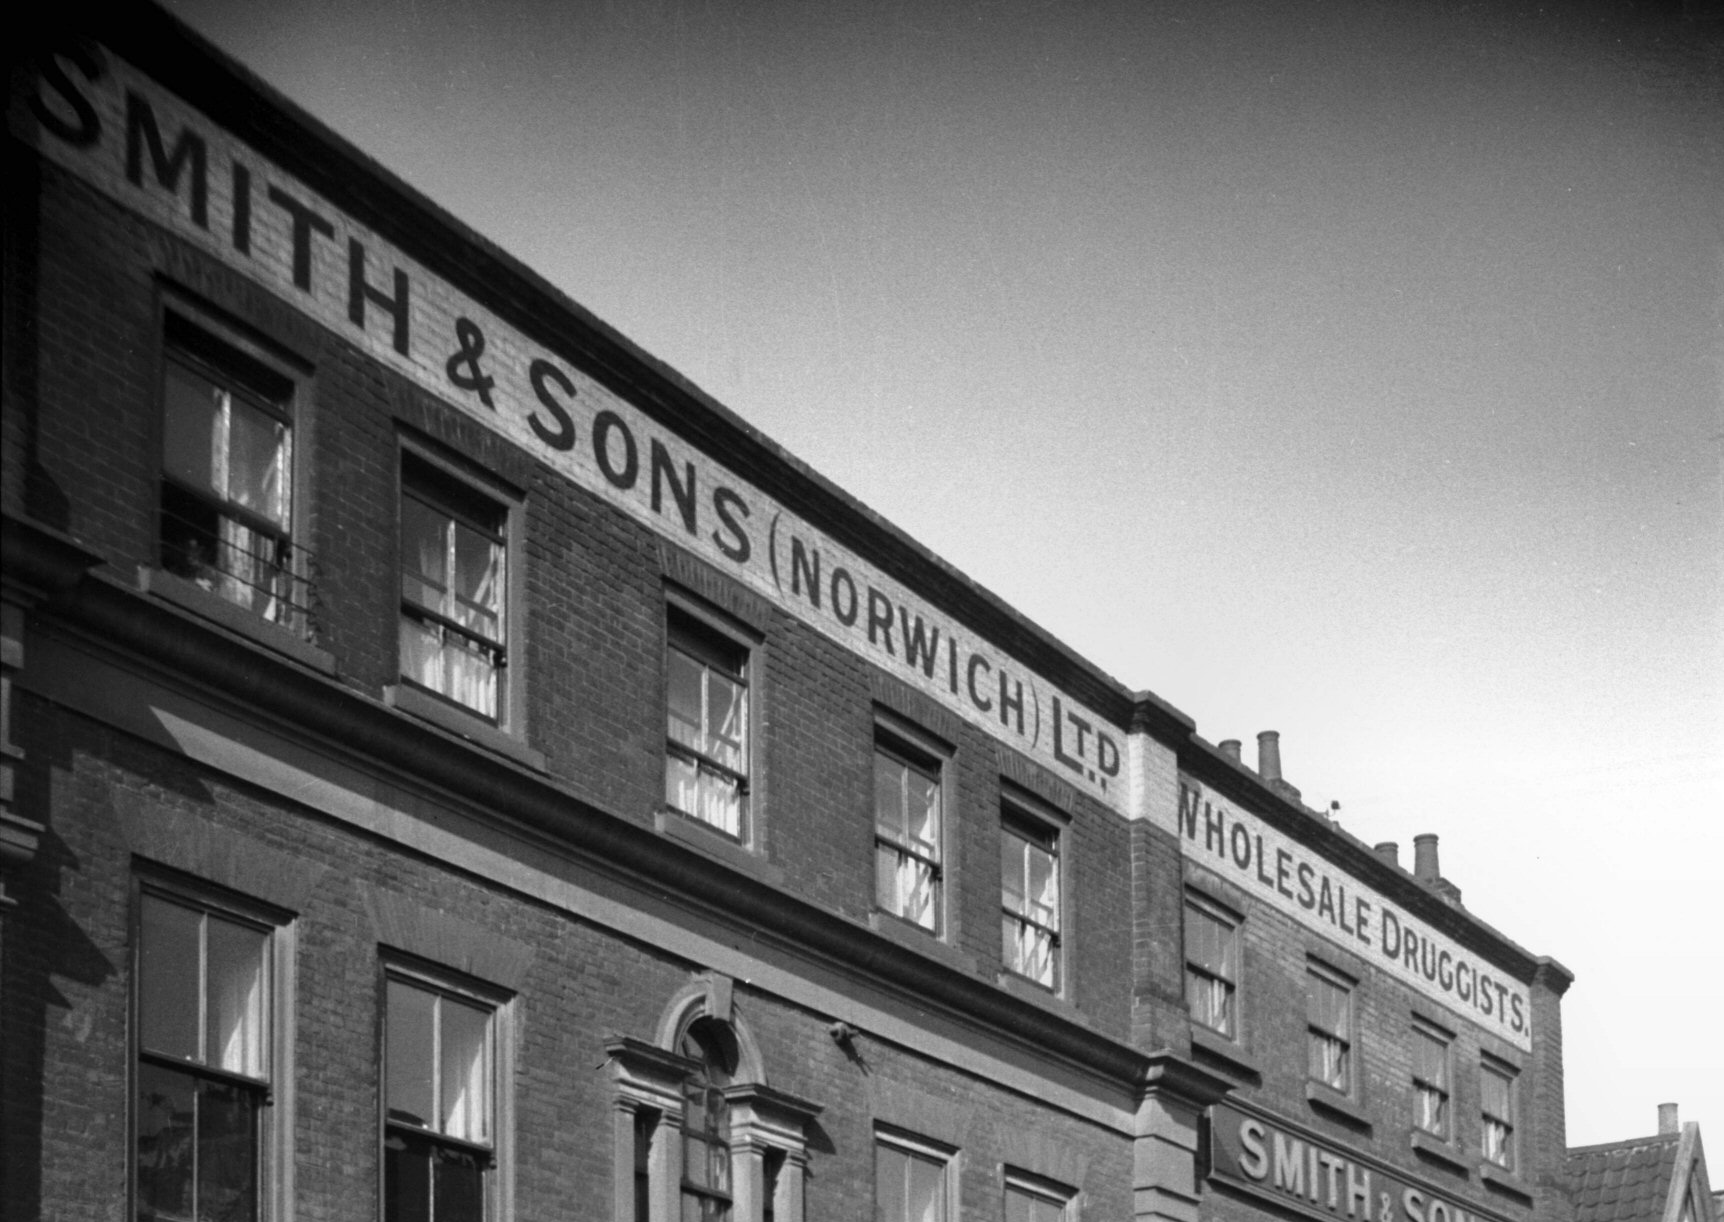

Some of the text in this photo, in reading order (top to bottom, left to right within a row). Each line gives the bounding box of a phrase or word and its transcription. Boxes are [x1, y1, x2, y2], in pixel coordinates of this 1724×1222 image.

[30, 40, 410, 359] SMITH
[445, 316, 496, 411] &
[527, 358, 751, 563] SONS
[769, 510, 1039, 750] (NORWICH)
[1382, 907, 1529, 1037] DRUGGISTS.
[1238, 1119, 1371, 1222] SMITH
